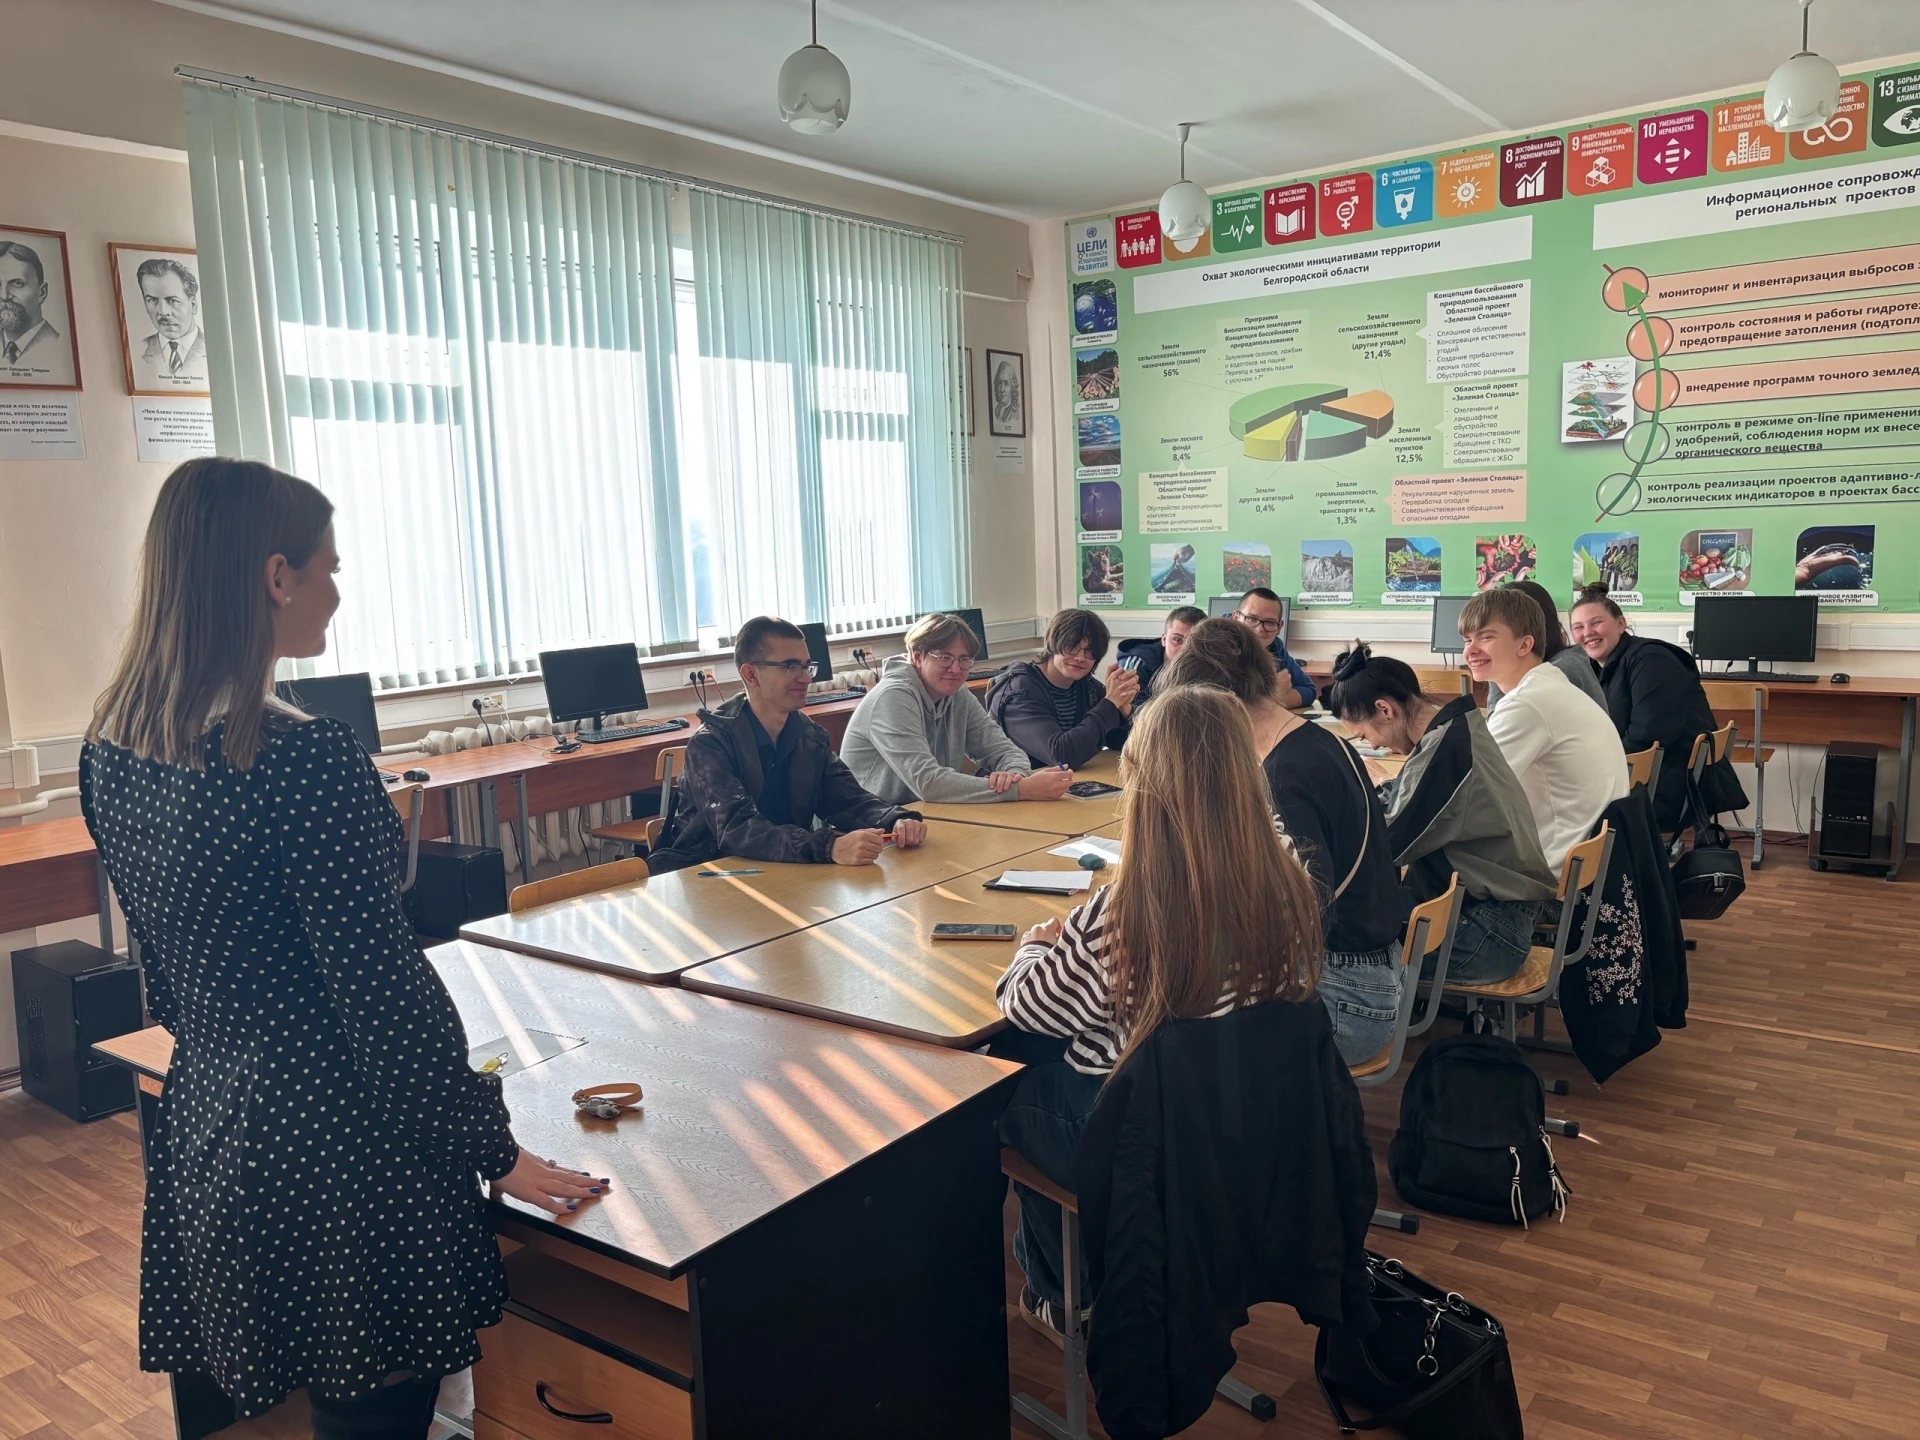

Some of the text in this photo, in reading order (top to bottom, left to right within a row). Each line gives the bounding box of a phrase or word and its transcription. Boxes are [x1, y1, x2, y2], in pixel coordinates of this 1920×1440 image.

[1879, 80, 1894, 97] 13
[1659, 116, 1695, 127] УМЕНЬШЕНИЕ
[1718, 110, 1729, 125] 11
[1734, 115, 1755, 123] ГОРОДА
[1643, 123, 1656, 138] 10
[1659, 124, 1694, 135] НЕРАВЕНСТВА
[1718, 121, 1754, 132] НАСЕЛЕННЫЕ
[1515, 140, 1561, 154] ДОСТОЙНАЯ РАБОТА
[1572, 136, 1579, 151] 9
[1505, 149, 1513, 163] 8
[1392, 169, 1408, 177] ЧИСТАЯ
[1441, 162, 1447, 175] 7
[1382, 173, 1388, 186] 6
[1324, 184, 1330, 196] 5
[1706, 180, 1833, 207] Информационное
[1269, 193, 1275, 206] 4
[1735, 184, 1916, 220] региональных проектов
[1217, 203, 1223, 215] 3
[1120, 220, 1124, 232] 1
[1077, 239, 1107, 254] ЦЕЛИ
[1078, 262, 1108, 271] РАЗВИТИЯ
[1202, 239, 1441, 282] Охват экологическими инициативами территории
[1263, 264, 1369, 286] Белгородской области
[1658, 283, 1730, 299] мониторинг
[1744, 269, 1846, 289] инвентаризация
[1849, 262, 1915, 278] выбросов
[1434, 283, 1523, 299] Концепция бассейнового
[1440, 292, 1517, 308] природопользования
[1446, 302, 1510, 315] Областной проект
[1245, 314, 1278, 324] Программа
[1444, 311, 1511, 324] «Зеленая Столица»
[1680, 306, 1862, 334] контроль состояния и работы
[1338, 319, 1420, 333] сельскохозяйственного
[1437, 324, 1508, 337] Сплошное облесение
[1358, 331, 1398, 340] назначения
[1437, 331, 1526, 345] Консервация естественных
[1679, 329, 1782, 348] предотвращение
[1785, 322, 1856, 336] затопления
[1352, 338, 1406, 350] (другие угодья)
[1365, 349, 1391, 360] 21,4%
[1437, 346, 1459, 355] угодий
[1437, 350, 1514, 362] Создание прибалочных
[1164, 368, 1179, 377] 56%
[1437, 367, 1515, 380] Обустройство родников
[1686, 379, 1750, 393] внедрение
[1753, 374, 1815, 387] программ
[1818, 370, 1869, 381] точного
[1454, 384, 1491, 393] Областной
[1452, 391, 1519, 401] «Зеленая Столица»
[1454, 405, 1493, 413] Озеленение
[1454, 414, 1498, 422] ландшафтное
[1676, 413, 1840, 433] контроль в режиме on-line
[1454, 422, 1498, 431] обустройство
[1454, 430, 1520, 439] Совершенствование
[1675, 432, 1742, 448] удобрений,
[1746, 427, 1823, 442] соблюдения
[1826, 424, 1860, 436] норм
[1864, 424, 1880, 433] их
[1454, 440, 1490, 448] обращения
[1173, 453, 1191, 461] 8,4%
[1454, 447, 1520, 456] Совершенствование
[1675, 442, 1823, 461] органического вещества
[1396, 454, 1423, 463] 12,5%
[1454, 457, 1490, 465] обращения
[1395, 478, 1430, 486] Областной
[1647, 482, 1701, 493] контроль
[1704, 477, 1775, 490] реализации
[1779, 474, 1837, 487] проектов
[1239, 494, 1294, 504] других категорий
[1316, 489, 1378, 498] промышленности,
[1402, 490, 1448, 498] Рекультивация
[1449, 488, 1489, 496] нарушенных
[1647, 484, 1920, 505] экологических индикаторов в проектах басс
[1327, 498, 1366, 506] энергетики,
[1256, 504, 1275, 513] 0,4%
[1336, 516, 1357, 525] 1,3%
